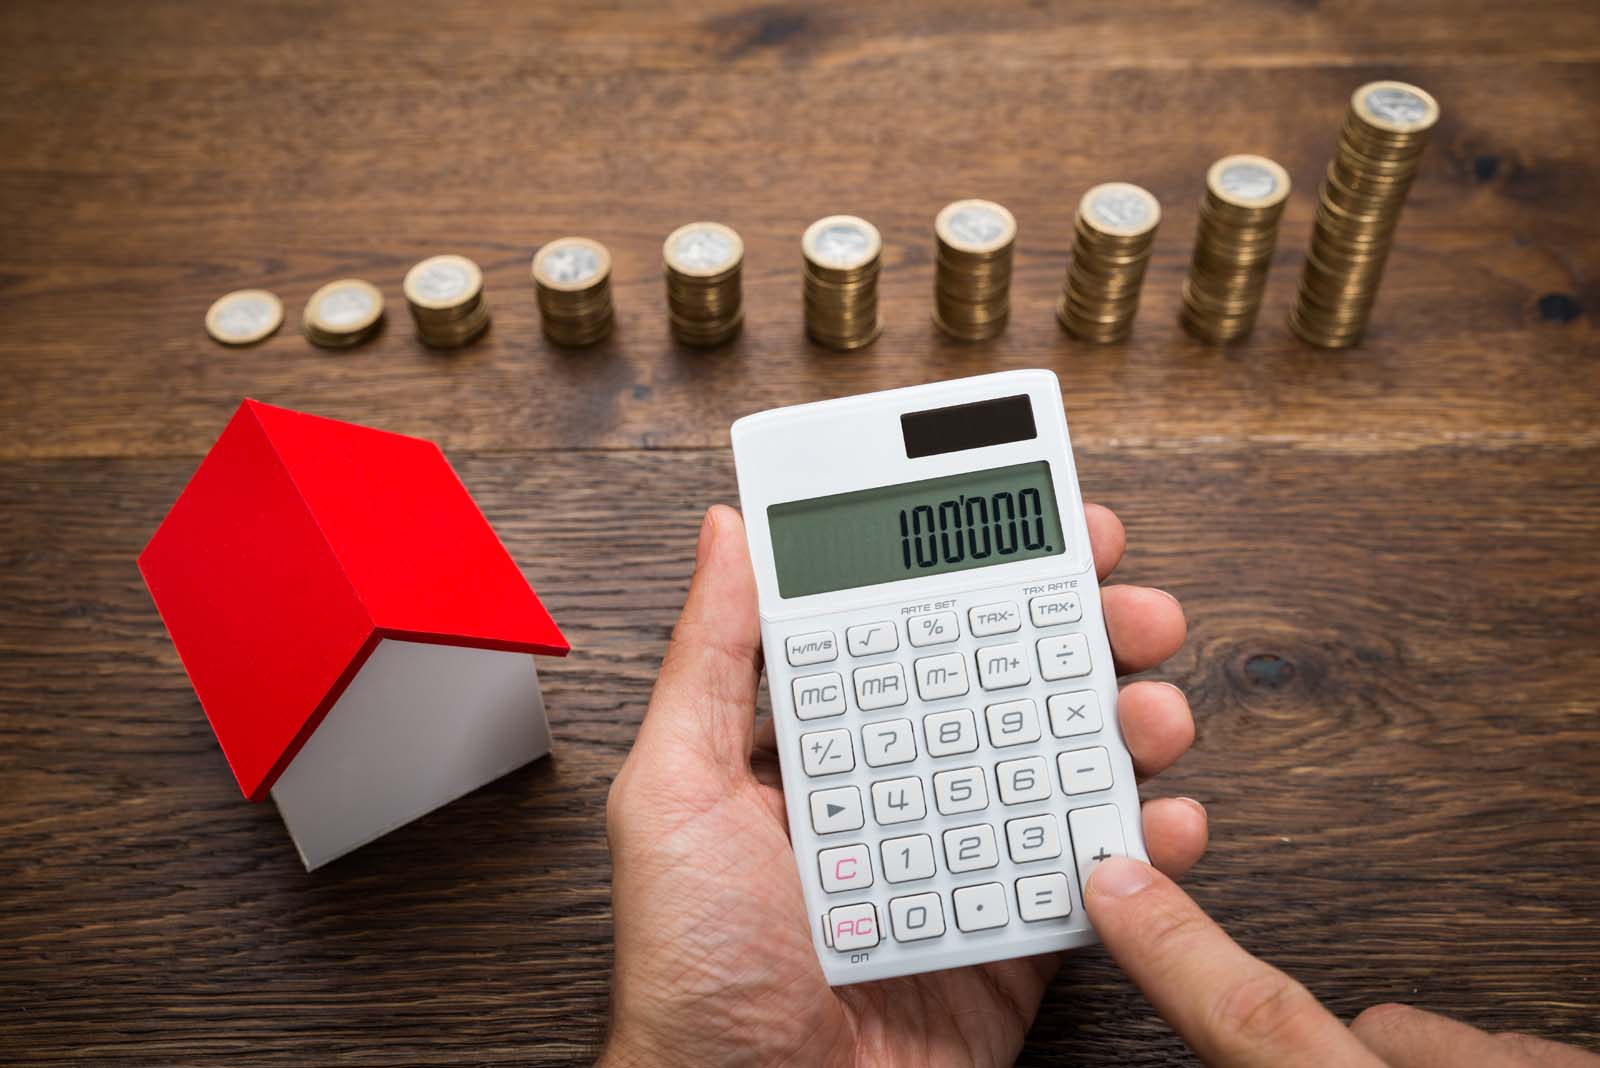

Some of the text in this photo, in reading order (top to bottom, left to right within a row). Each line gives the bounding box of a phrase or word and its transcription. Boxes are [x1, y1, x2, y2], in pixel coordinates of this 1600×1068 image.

[1022, 580, 1078, 596] TAX RATE
[901, 600, 957, 615] RATE SET
[978, 612, 1014, 624] TAX-
[1038, 603, 1075, 614] TAX+
[923, 619, 944, 637] %
[792, 641, 833, 654] H/M/S
[800, 685, 838, 707] MC
[939, 721, 962, 744] 8
[1001, 712, 1024, 735] 9
[877, 731, 898, 753] 7
[950, 779, 973, 802] 5
[1012, 769, 1035, 792] 6
[887, 790, 910, 811] 4
[958, 837, 982, 861] 2
[1022, 827, 1045, 850] 3
[835, 858, 857, 881] C
[901, 848, 910, 870] 1
[836, 918, 873, 939] AC
[906, 907, 927, 930] 0
